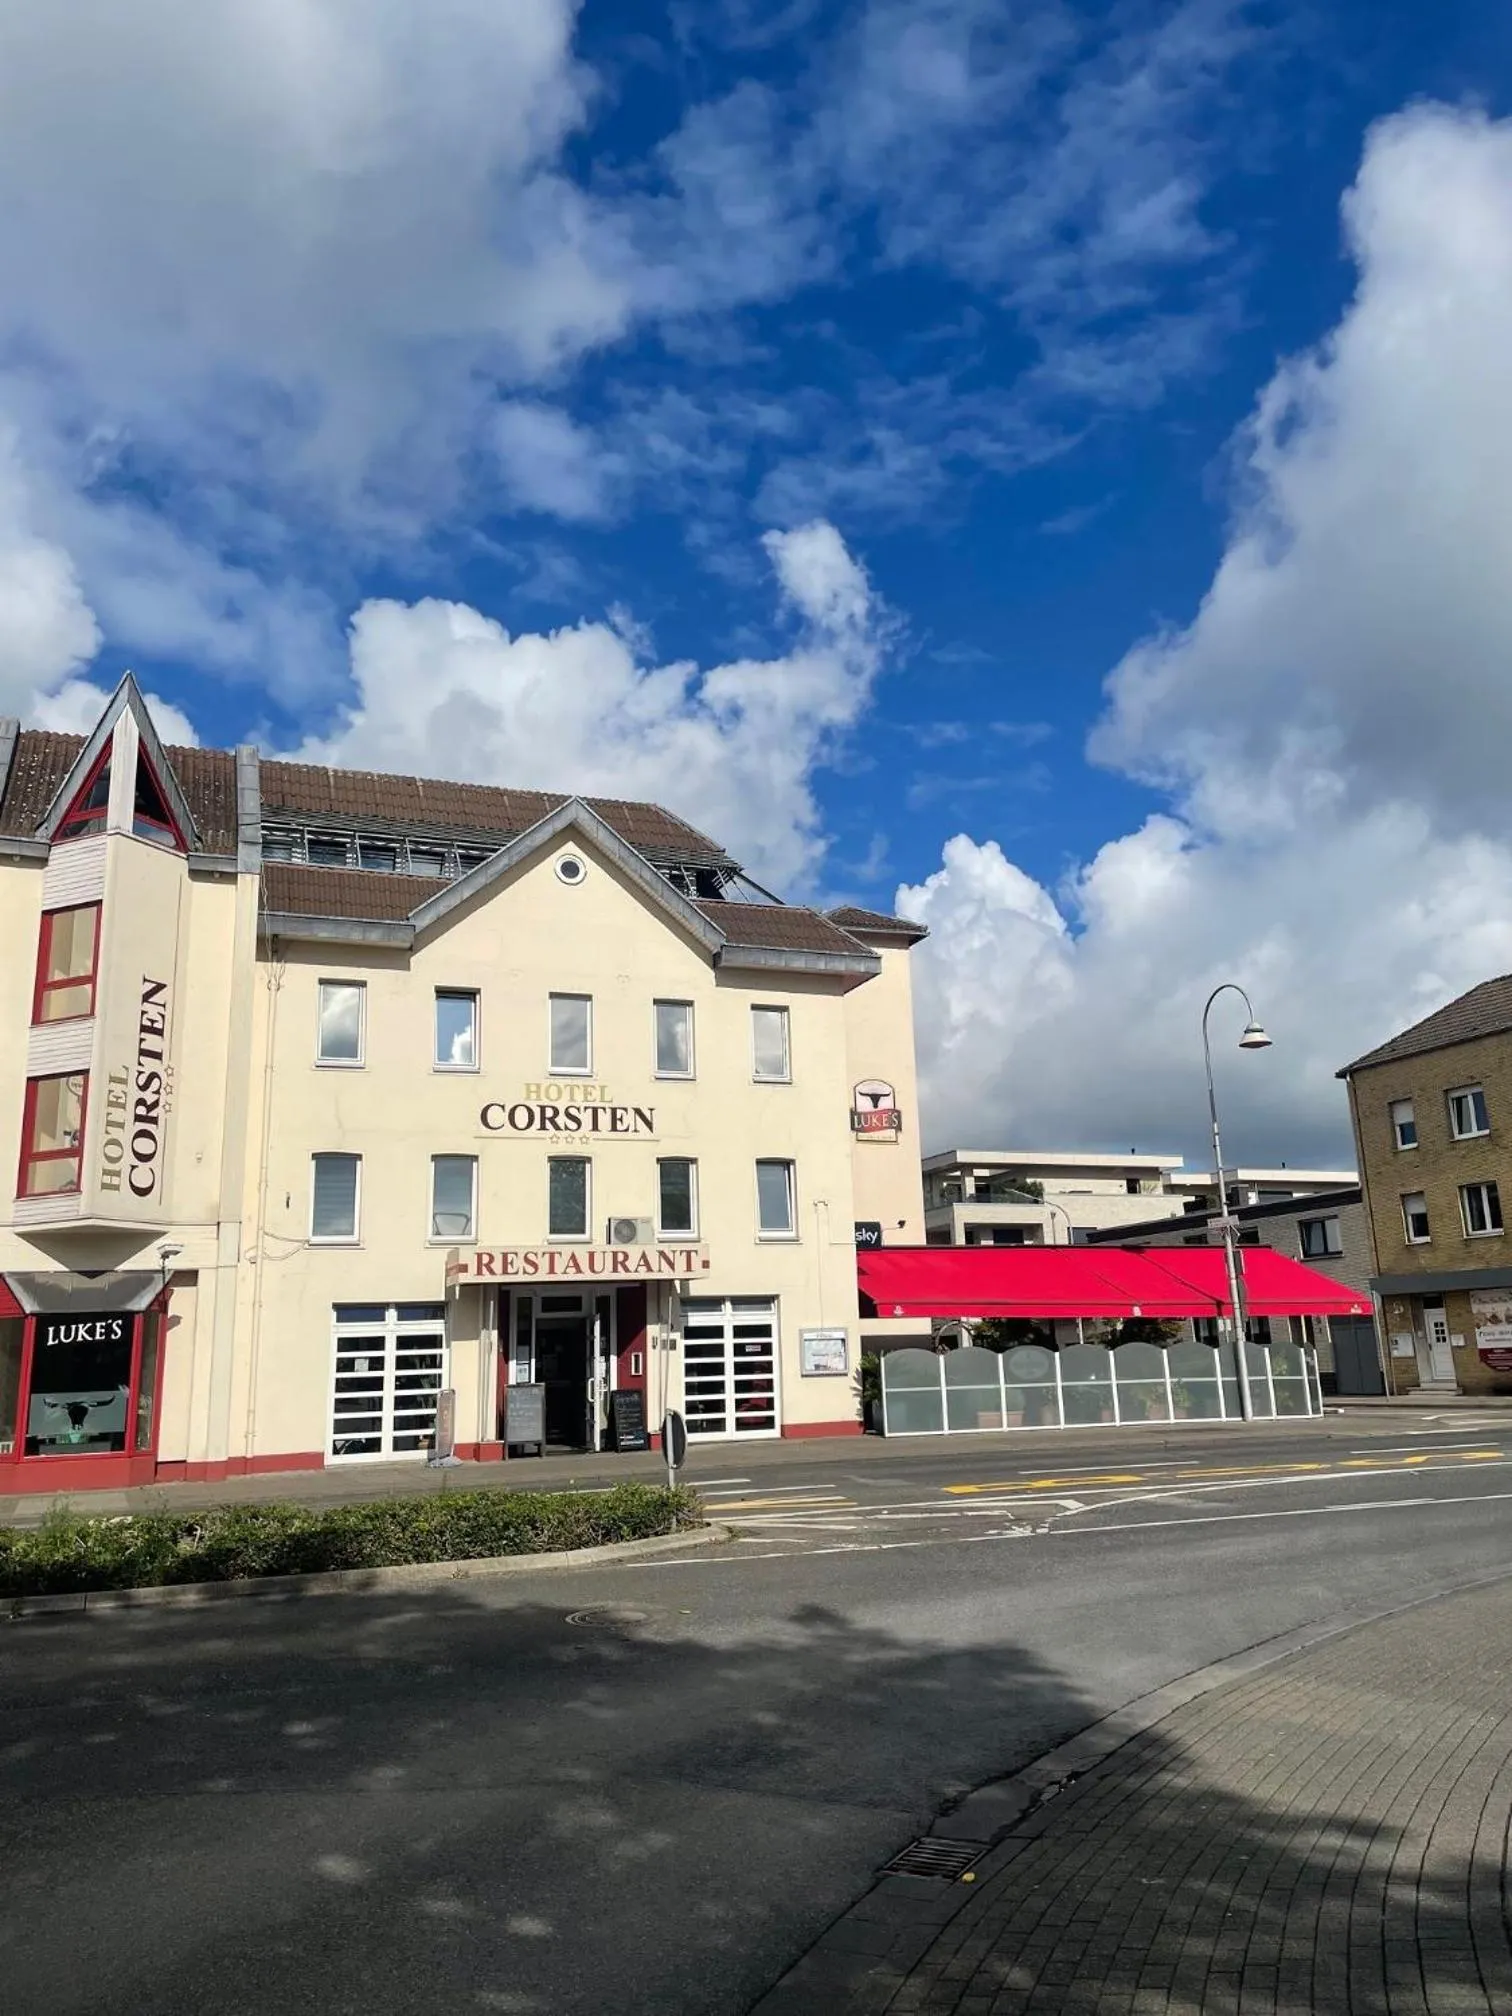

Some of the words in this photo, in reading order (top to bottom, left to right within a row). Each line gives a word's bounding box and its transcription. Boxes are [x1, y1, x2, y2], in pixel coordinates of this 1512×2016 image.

[128, 974, 168, 1198] CORSTEN
[523, 1082, 614, 1103] HOTEL
[100, 1064, 130, 1193] HOTEL
[480, 1102, 656, 1134] CORSTEN
[855, 1227, 878, 1244] sky
[473, 1248, 699, 1277] RESTAURANT
